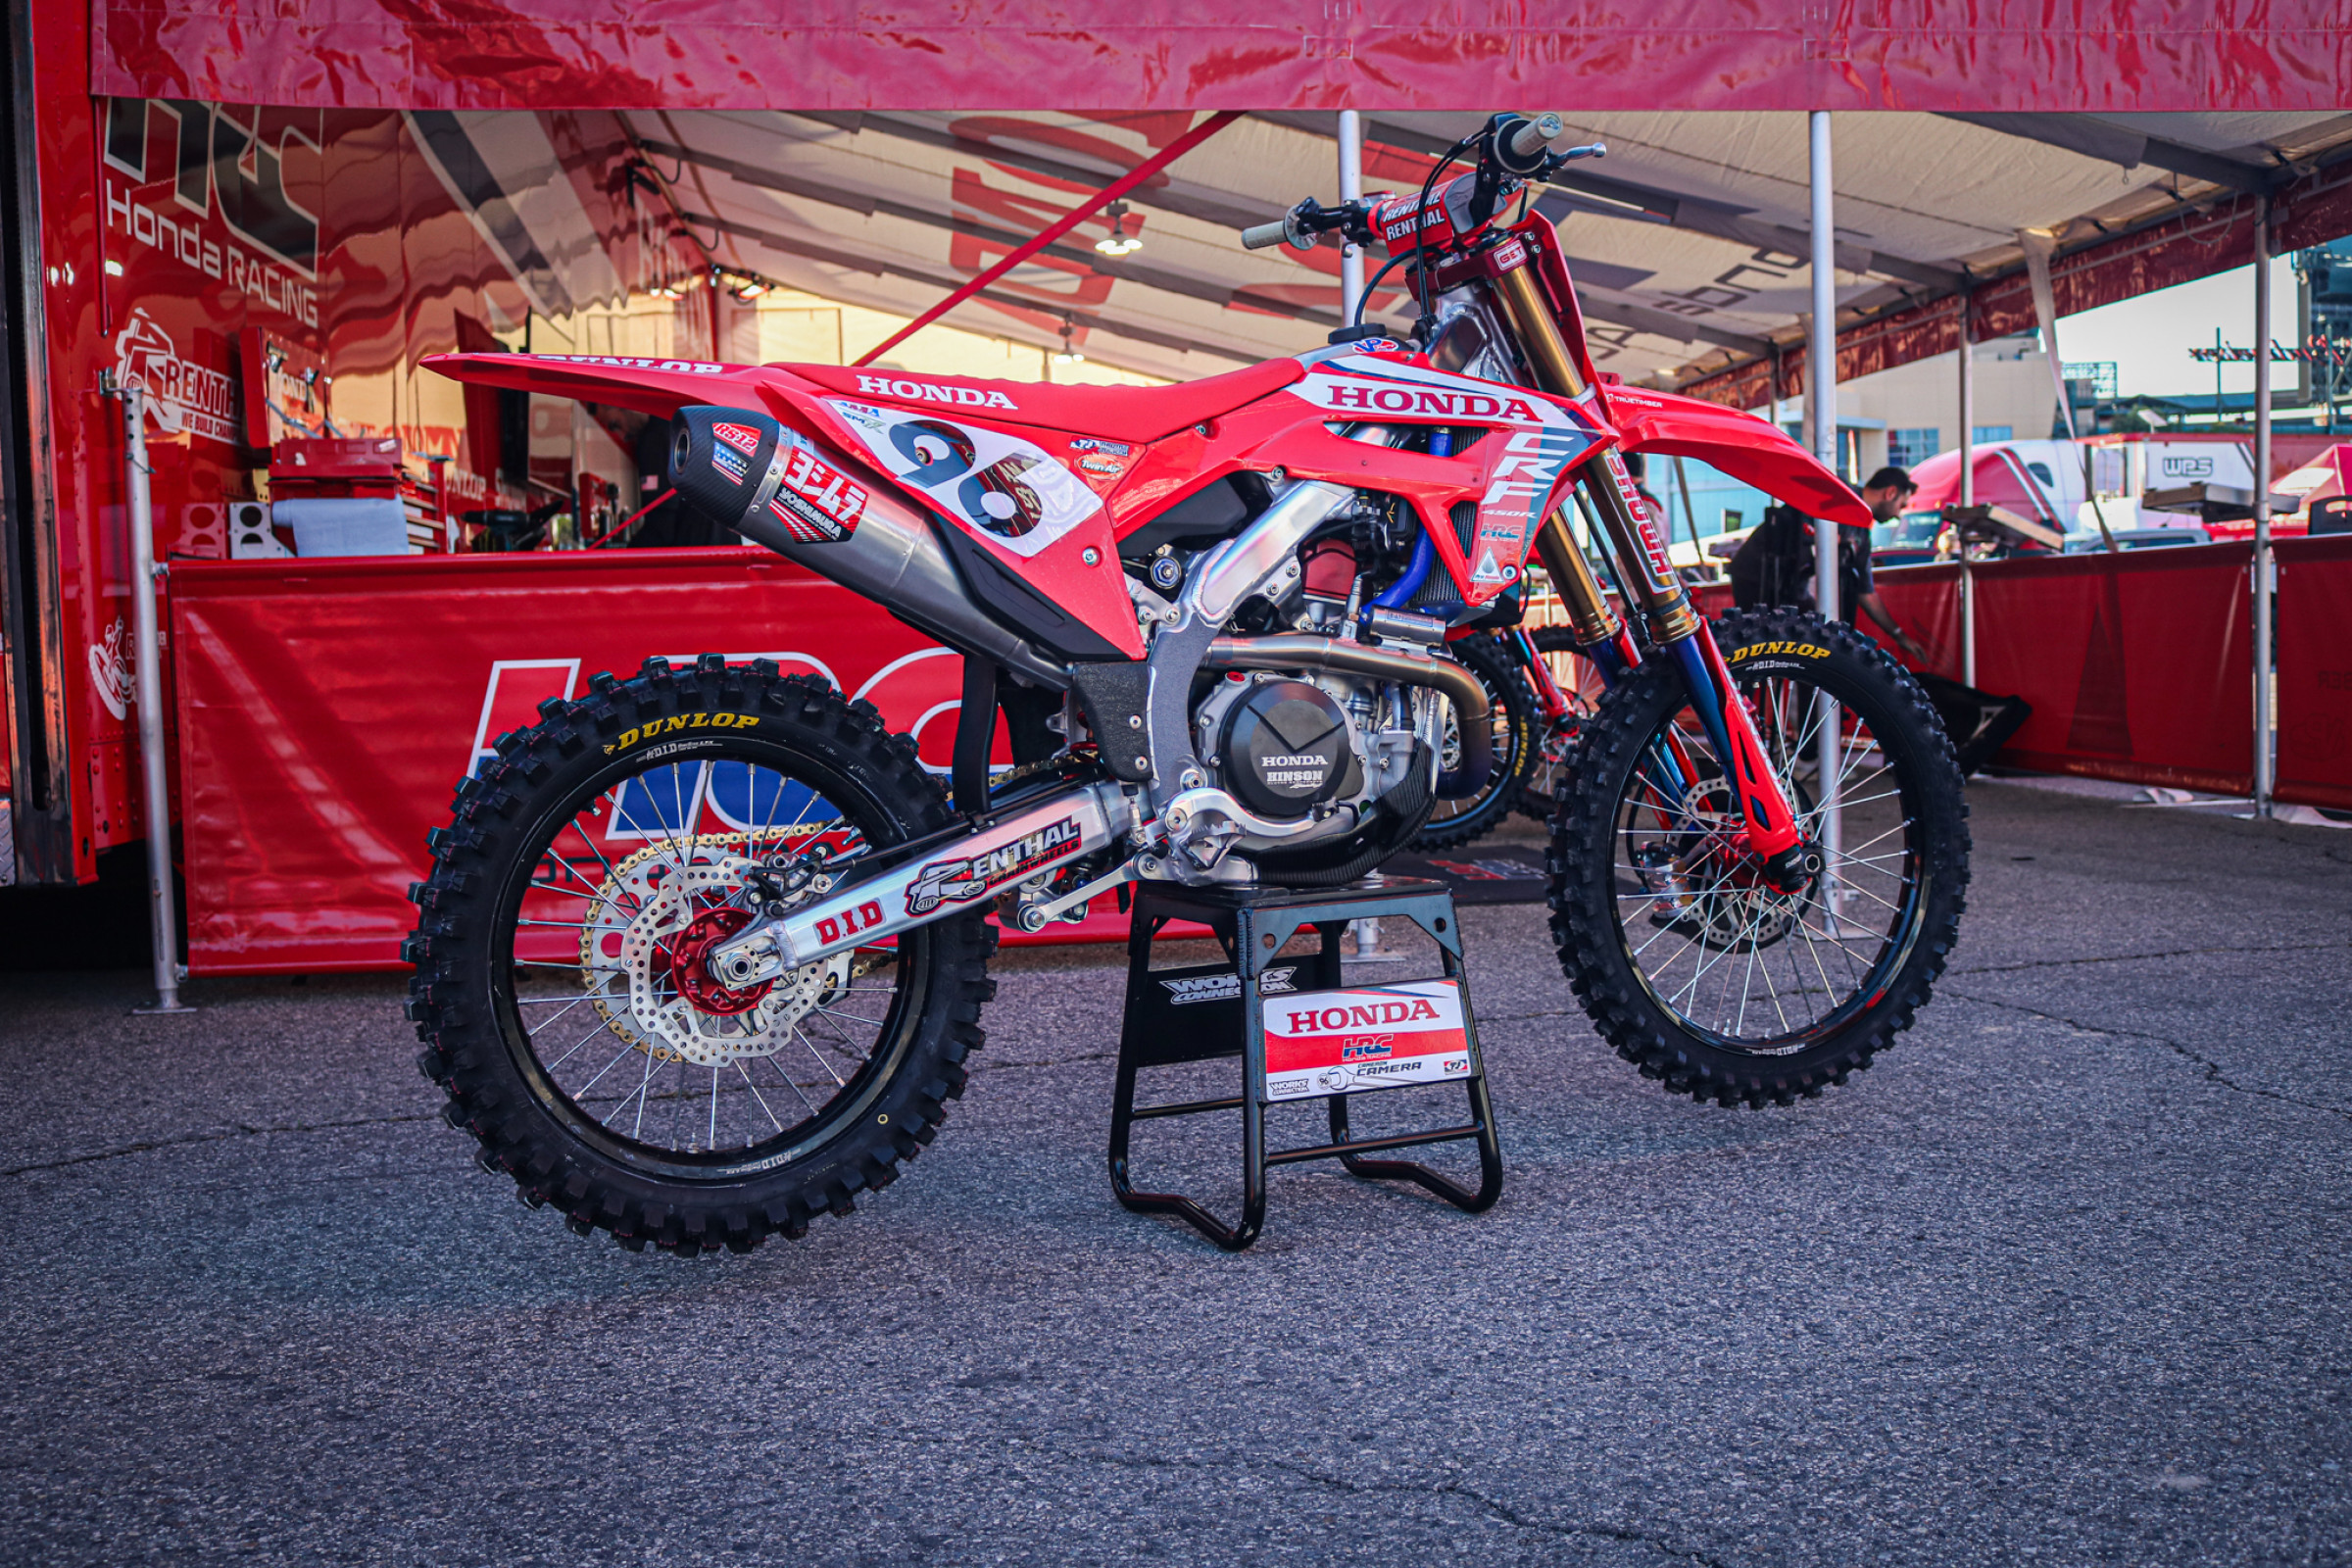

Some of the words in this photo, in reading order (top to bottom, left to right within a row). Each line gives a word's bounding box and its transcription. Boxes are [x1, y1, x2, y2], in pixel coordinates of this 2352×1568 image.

[1382, 190, 1442, 223] RENTAL
[1385, 208, 1446, 242] RENTAL
[106, 178, 222, 280] Honda
[226, 244, 319, 330] RACING
[1497, 243, 1527, 266] GET
[162, 354, 244, 421] RENTH
[856, 373, 1019, 411] HONDA
[1326, 384, 1544, 423] HONDA
[1614, 395, 1664, 408] TRUETIMBER
[888, 418, 1043, 538] 96
[1080, 459, 1103, 471] Twin
[1104, 463, 1122, 474] Air
[1480, 431, 1576, 507] CRF
[2163, 457, 2214, 477] WPS
[784, 450, 868, 523] ヨシムラ
[778, 486, 843, 538] YOSHIMURA
[1481, 509, 1539, 519] 450R
[1603, 452, 1675, 578] SHOWA
[1731, 640, 1833, 663] DUNLOP
[616, 711, 760, 751] DUNLOP
[1261, 755, 1329, 767] HONDA
[1266, 769, 1323, 782] HINSON
[1286, 998, 1441, 1035] HONDA
[1342, 1033, 1395, 1058] HRC
[1356, 1061, 1423, 1077] CAMERA
